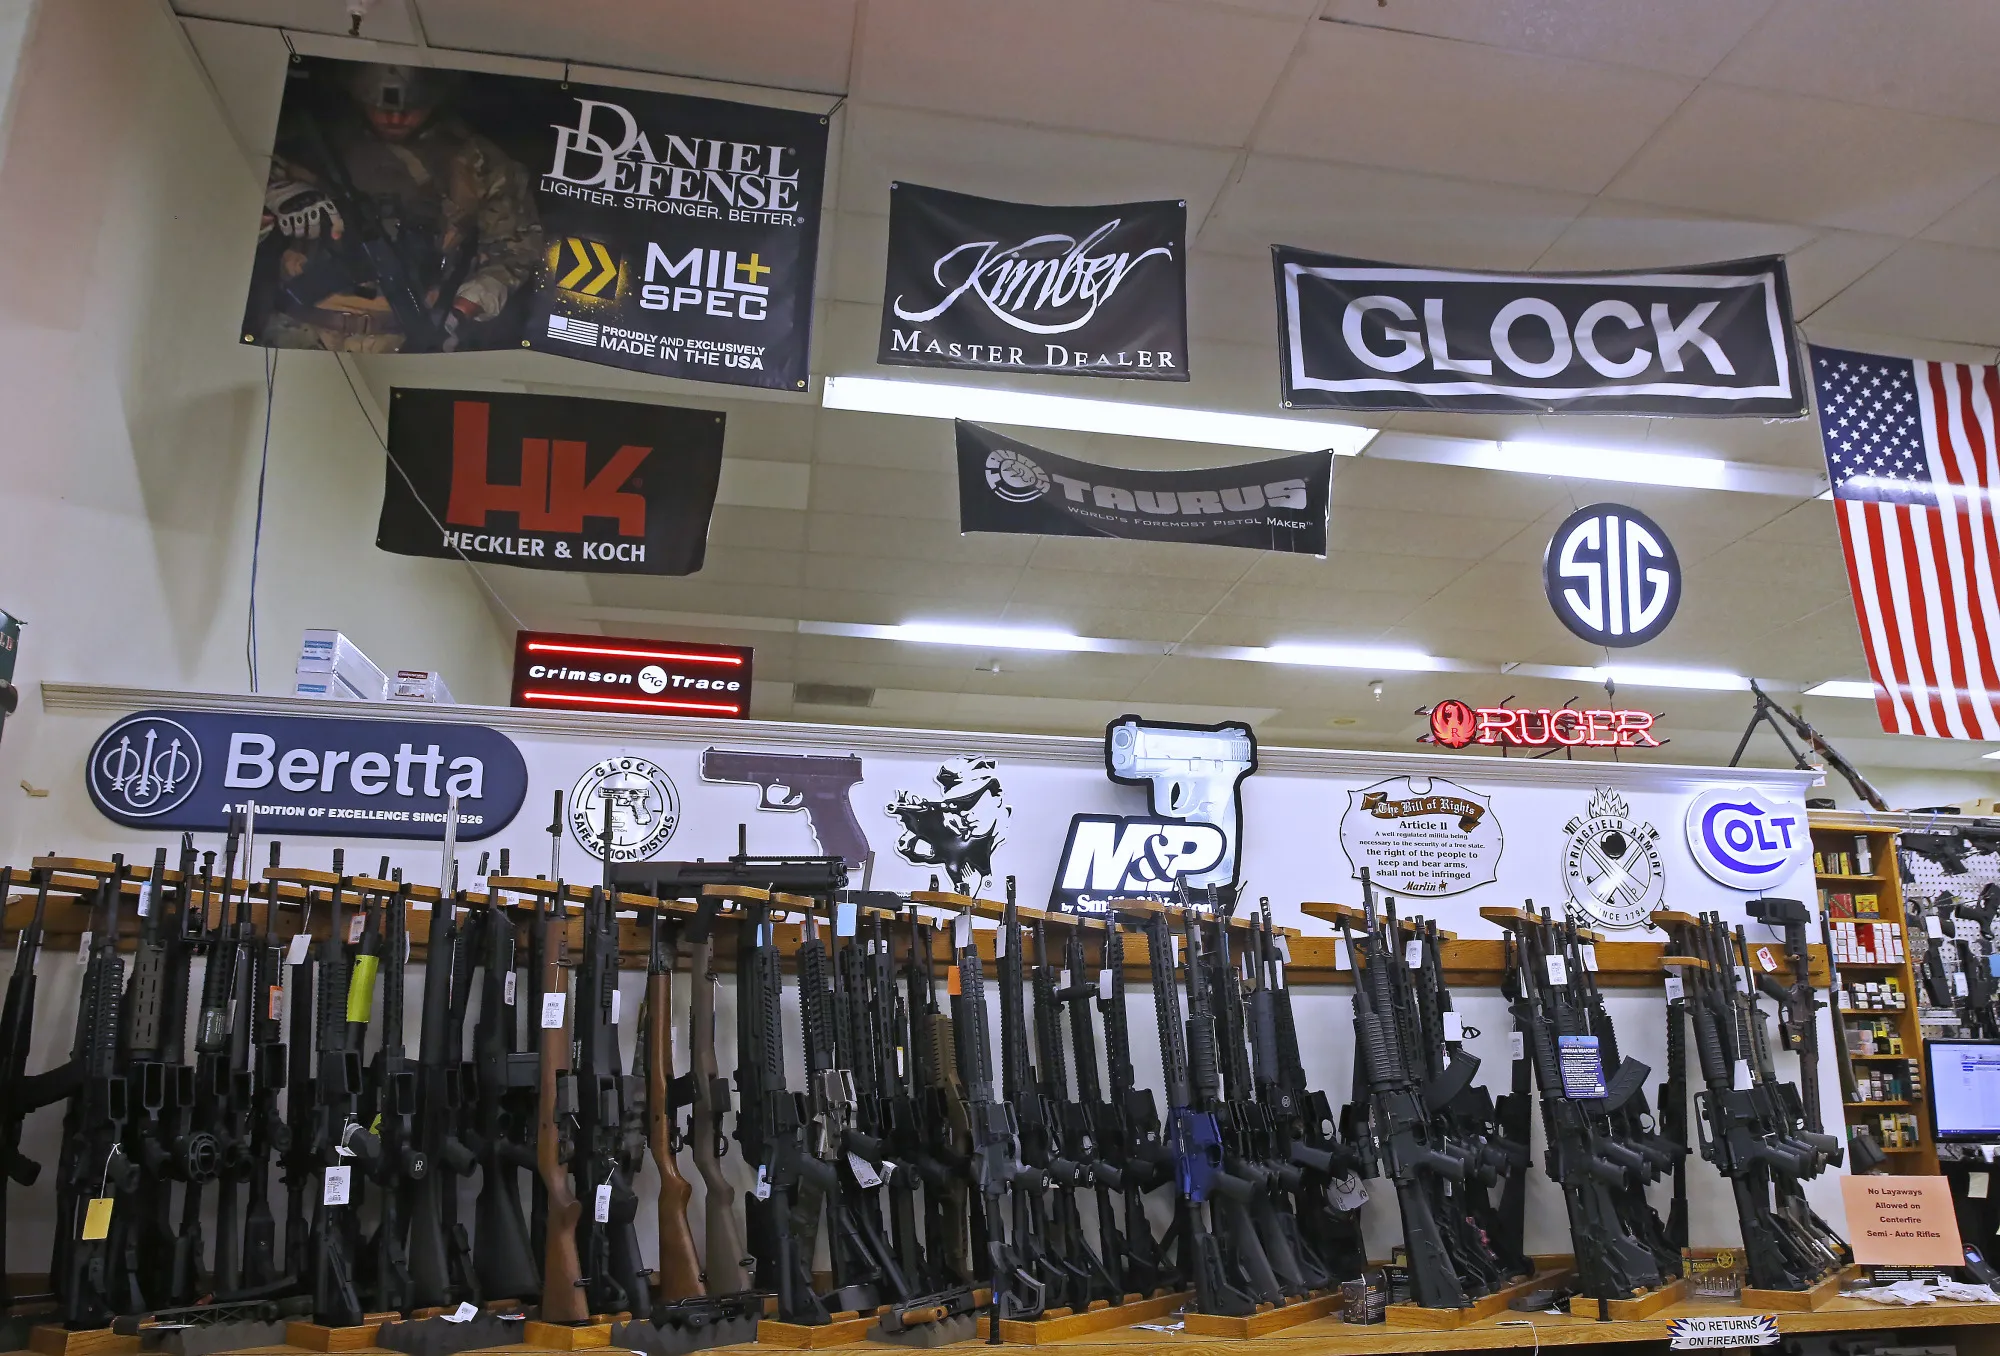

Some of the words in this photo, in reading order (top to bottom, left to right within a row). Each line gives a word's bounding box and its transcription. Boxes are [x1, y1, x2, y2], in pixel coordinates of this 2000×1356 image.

[542, 124, 799, 212] DEFENSE
[540, 179, 617, 207] LIGHTER.
[624, 197, 722, 220] STRONGER.
[893, 218, 1173, 334] Kimber
[640, 284, 767, 321] SPEC
[601, 335, 655, 358] MADE
[660, 347, 678, 362] IN
[683, 349, 720, 366] THE
[724, 355, 764, 371] USA
[602, 325, 658, 344] PROUDLY
[660, 336, 684, 348] AND
[687, 339, 766, 357] EXCLUSIVELY
[1342, 295, 1736, 379] GLOCK
[446, 400, 653, 537] HK
[985, 449, 1050, 490] TAURUS
[1052, 474, 1307, 515] TAURUS
[443, 530, 544, 558] HECKLER
[554, 541, 572, 559] &
[582, 541, 646, 562] KOCH
[1560, 515, 1670, 635] SIG
[529, 665, 632, 684] Crimson
[641, 672, 663, 688] CTC
[671, 675, 741, 691] Trace
[1476, 708, 1660, 746] RUGER
[224, 732, 484, 799] Beretta
[595, 760, 658, 778] GLOCK
[221, 803, 232, 814] A
[308, 807, 325, 818] OF
[328, 808, 410, 821] EXCELLENCE
[1375, 802, 1398, 816] The
[1400, 800, 1423, 816] Bill
[1426, 799, 1437, 810] of
[1441, 797, 1475, 816] Rights
[574, 813, 637, 860] SAFE-ACION
[640, 816, 675, 856] PISTOLS
[1399, 820, 1437, 830] Article
[1450, 833, 1468, 841] being
[1702, 801, 1795, 874] COLT
[1061, 821, 1222, 891] M&P
[1384, 849, 1407, 858] right
[1409, 849, 1418, 857] of
[1437, 851, 1466, 860] people
[1469, 851, 1478, 859] to
[1414, 841, 1440, 849] security
[1569, 819, 1624, 877] SPRINGFIELD
[1630, 827, 1662, 878] ARMORY
[1378, 860, 1400, 868] keep
[1402, 860, 1419, 868] and
[1421, 860, 1442, 868] bear
[1400, 870, 1416, 878] not
[1418, 870, 1430, 878] be
[1431, 871, 1471, 880] infringed
[1402, 881, 1437, 892] Marlin
[1061, 903, 1074, 913] by
[1625, 907, 1646, 921] 1794
[1881, 1188, 1923, 1197] Layaways
[1895, 1230, 1914, 1238] Auto
[1916, 1230, 1940, 1238] Rifles
[1689, 1337, 1704, 1346] ON
[1707, 1335, 1760, 1346] FIREARMS
[1690, 1321, 1706, 1331] NO
[1708, 1320, 1758, 1331] RETURNS
